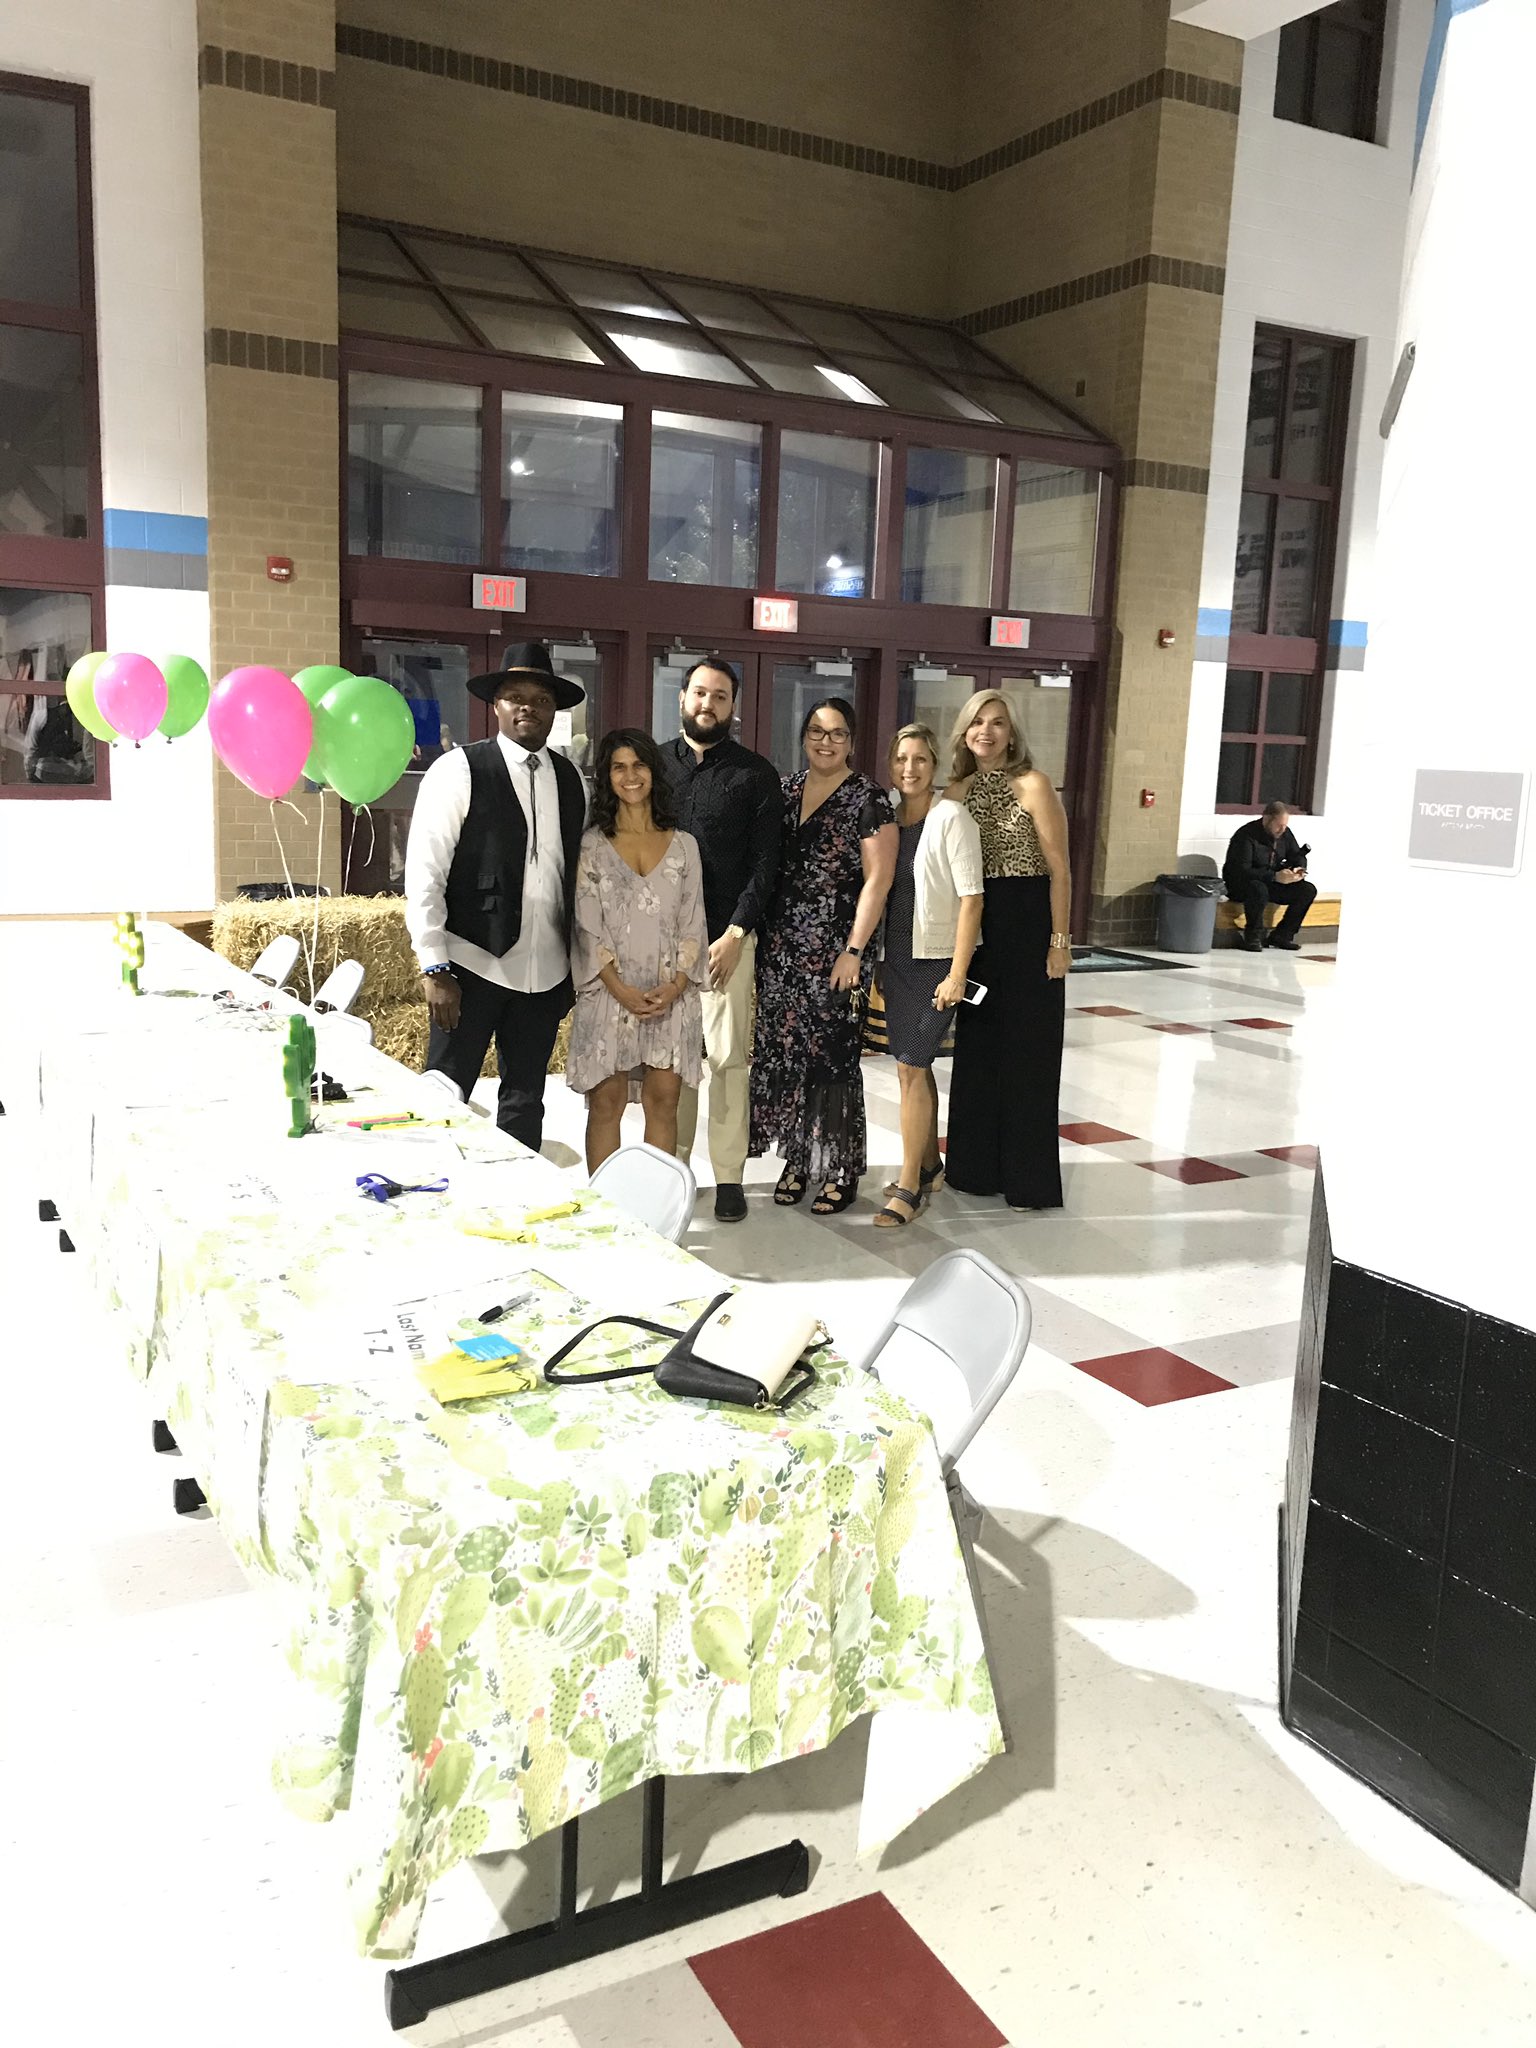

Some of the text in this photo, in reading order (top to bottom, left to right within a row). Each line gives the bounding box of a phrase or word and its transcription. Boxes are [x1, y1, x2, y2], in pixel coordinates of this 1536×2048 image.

[482, 578, 516, 609] EXIT
[760, 600, 791, 628] EXIT
[1418, 802, 1513, 822] TICKET OFFICE
[396, 1311, 427, 1361] Last Nam
